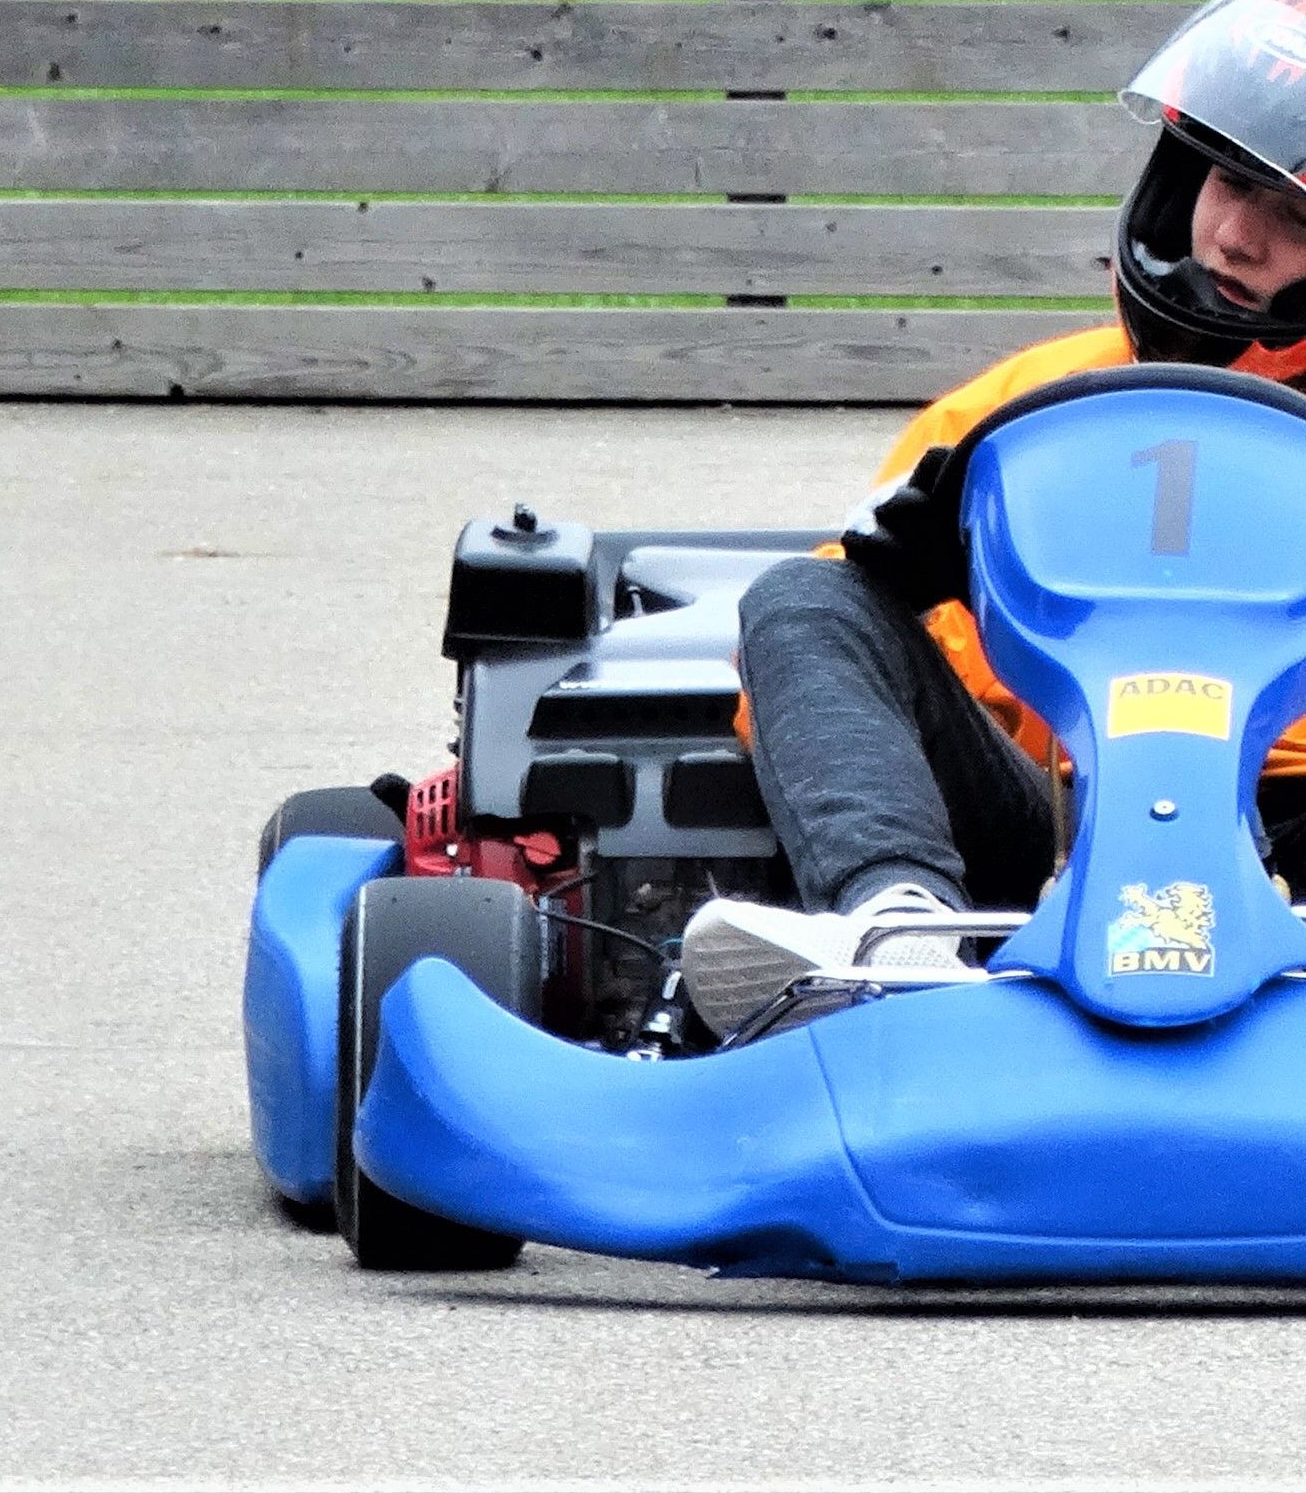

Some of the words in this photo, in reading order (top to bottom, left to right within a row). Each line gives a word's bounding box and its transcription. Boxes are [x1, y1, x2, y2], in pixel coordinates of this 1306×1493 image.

[1129, 437, 1200, 558] 1
[1118, 678, 1225, 700] ADAC
[1112, 950, 1212, 973] BMV
